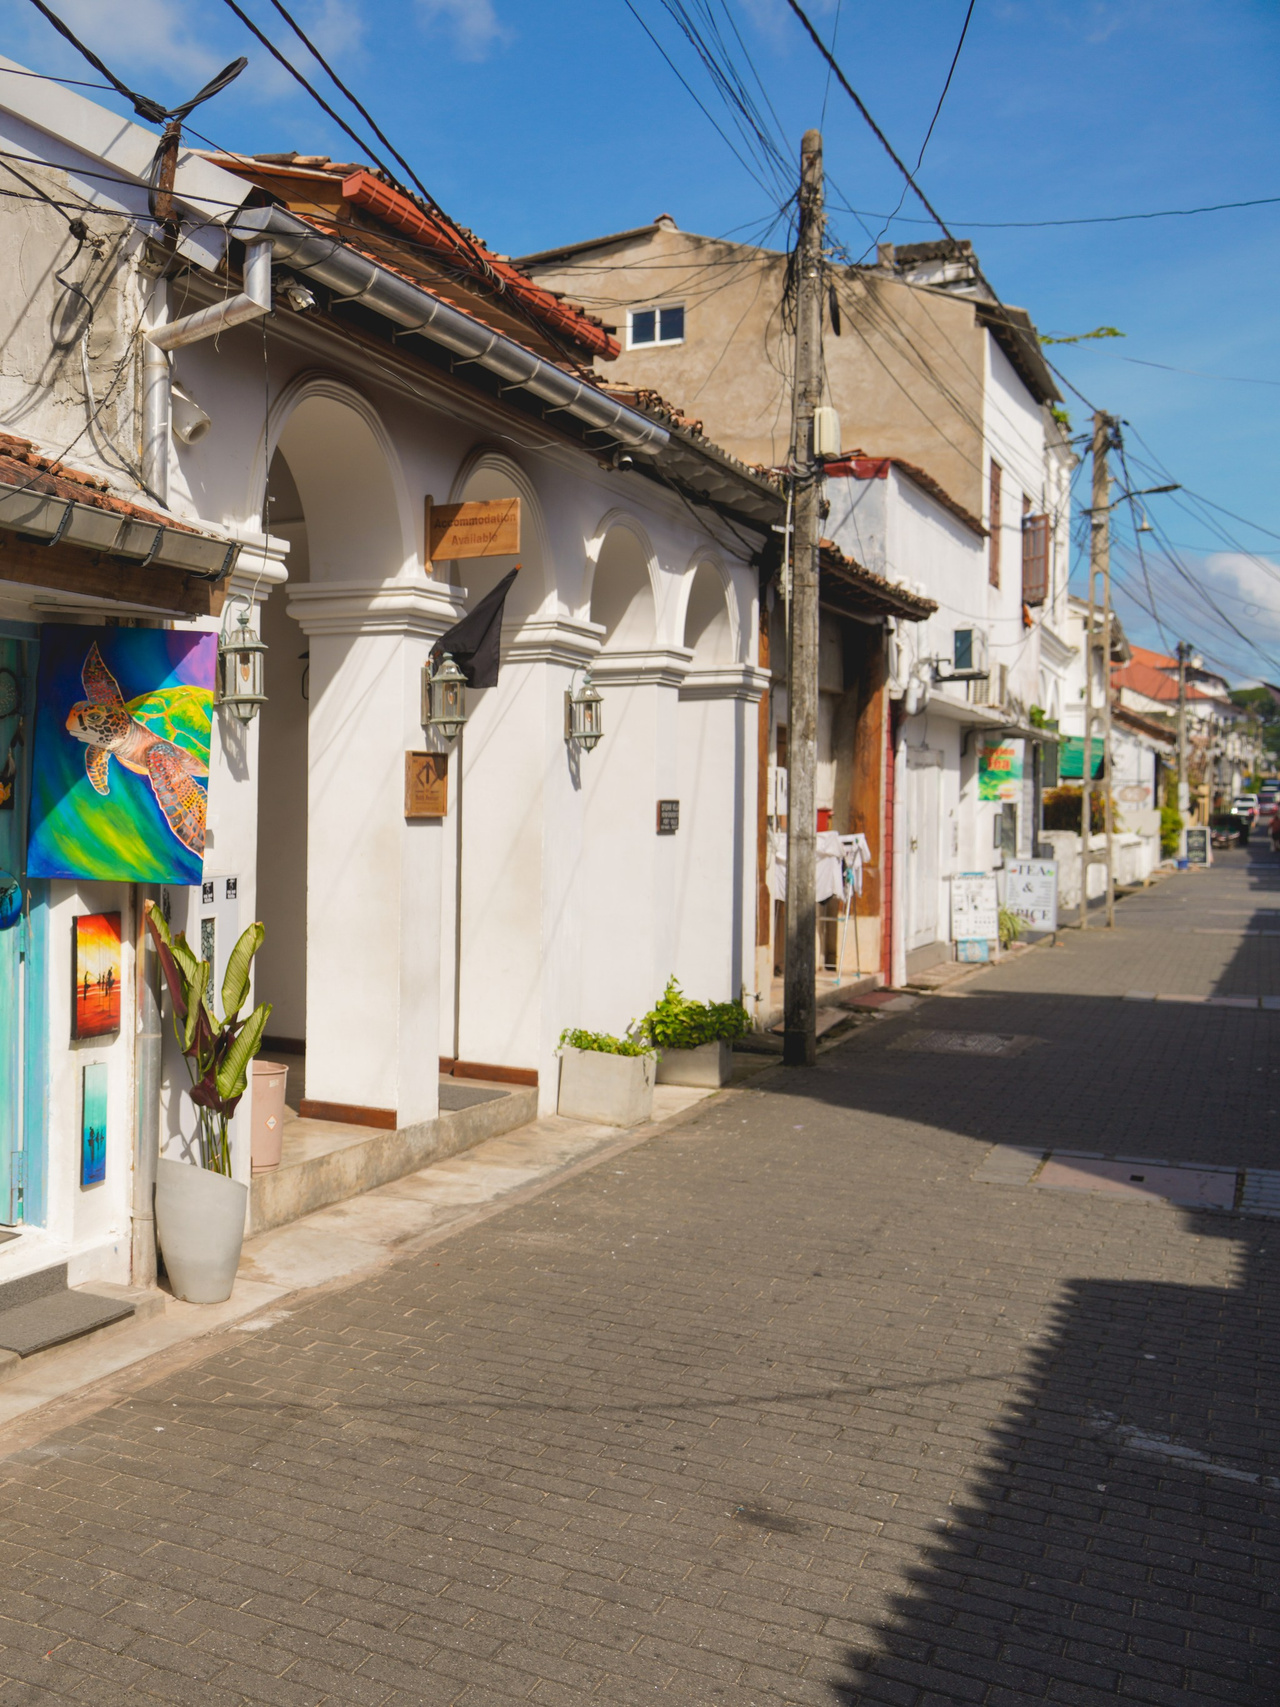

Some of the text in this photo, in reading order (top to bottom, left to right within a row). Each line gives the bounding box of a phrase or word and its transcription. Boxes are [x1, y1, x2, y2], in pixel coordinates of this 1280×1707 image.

[434, 512, 516, 529] Accommodation
[451, 531, 498, 546] Available
[987, 757, 1011, 771] Tea
[1016, 864, 1047, 876] TEA
[1022, 882, 1033, 893] &
